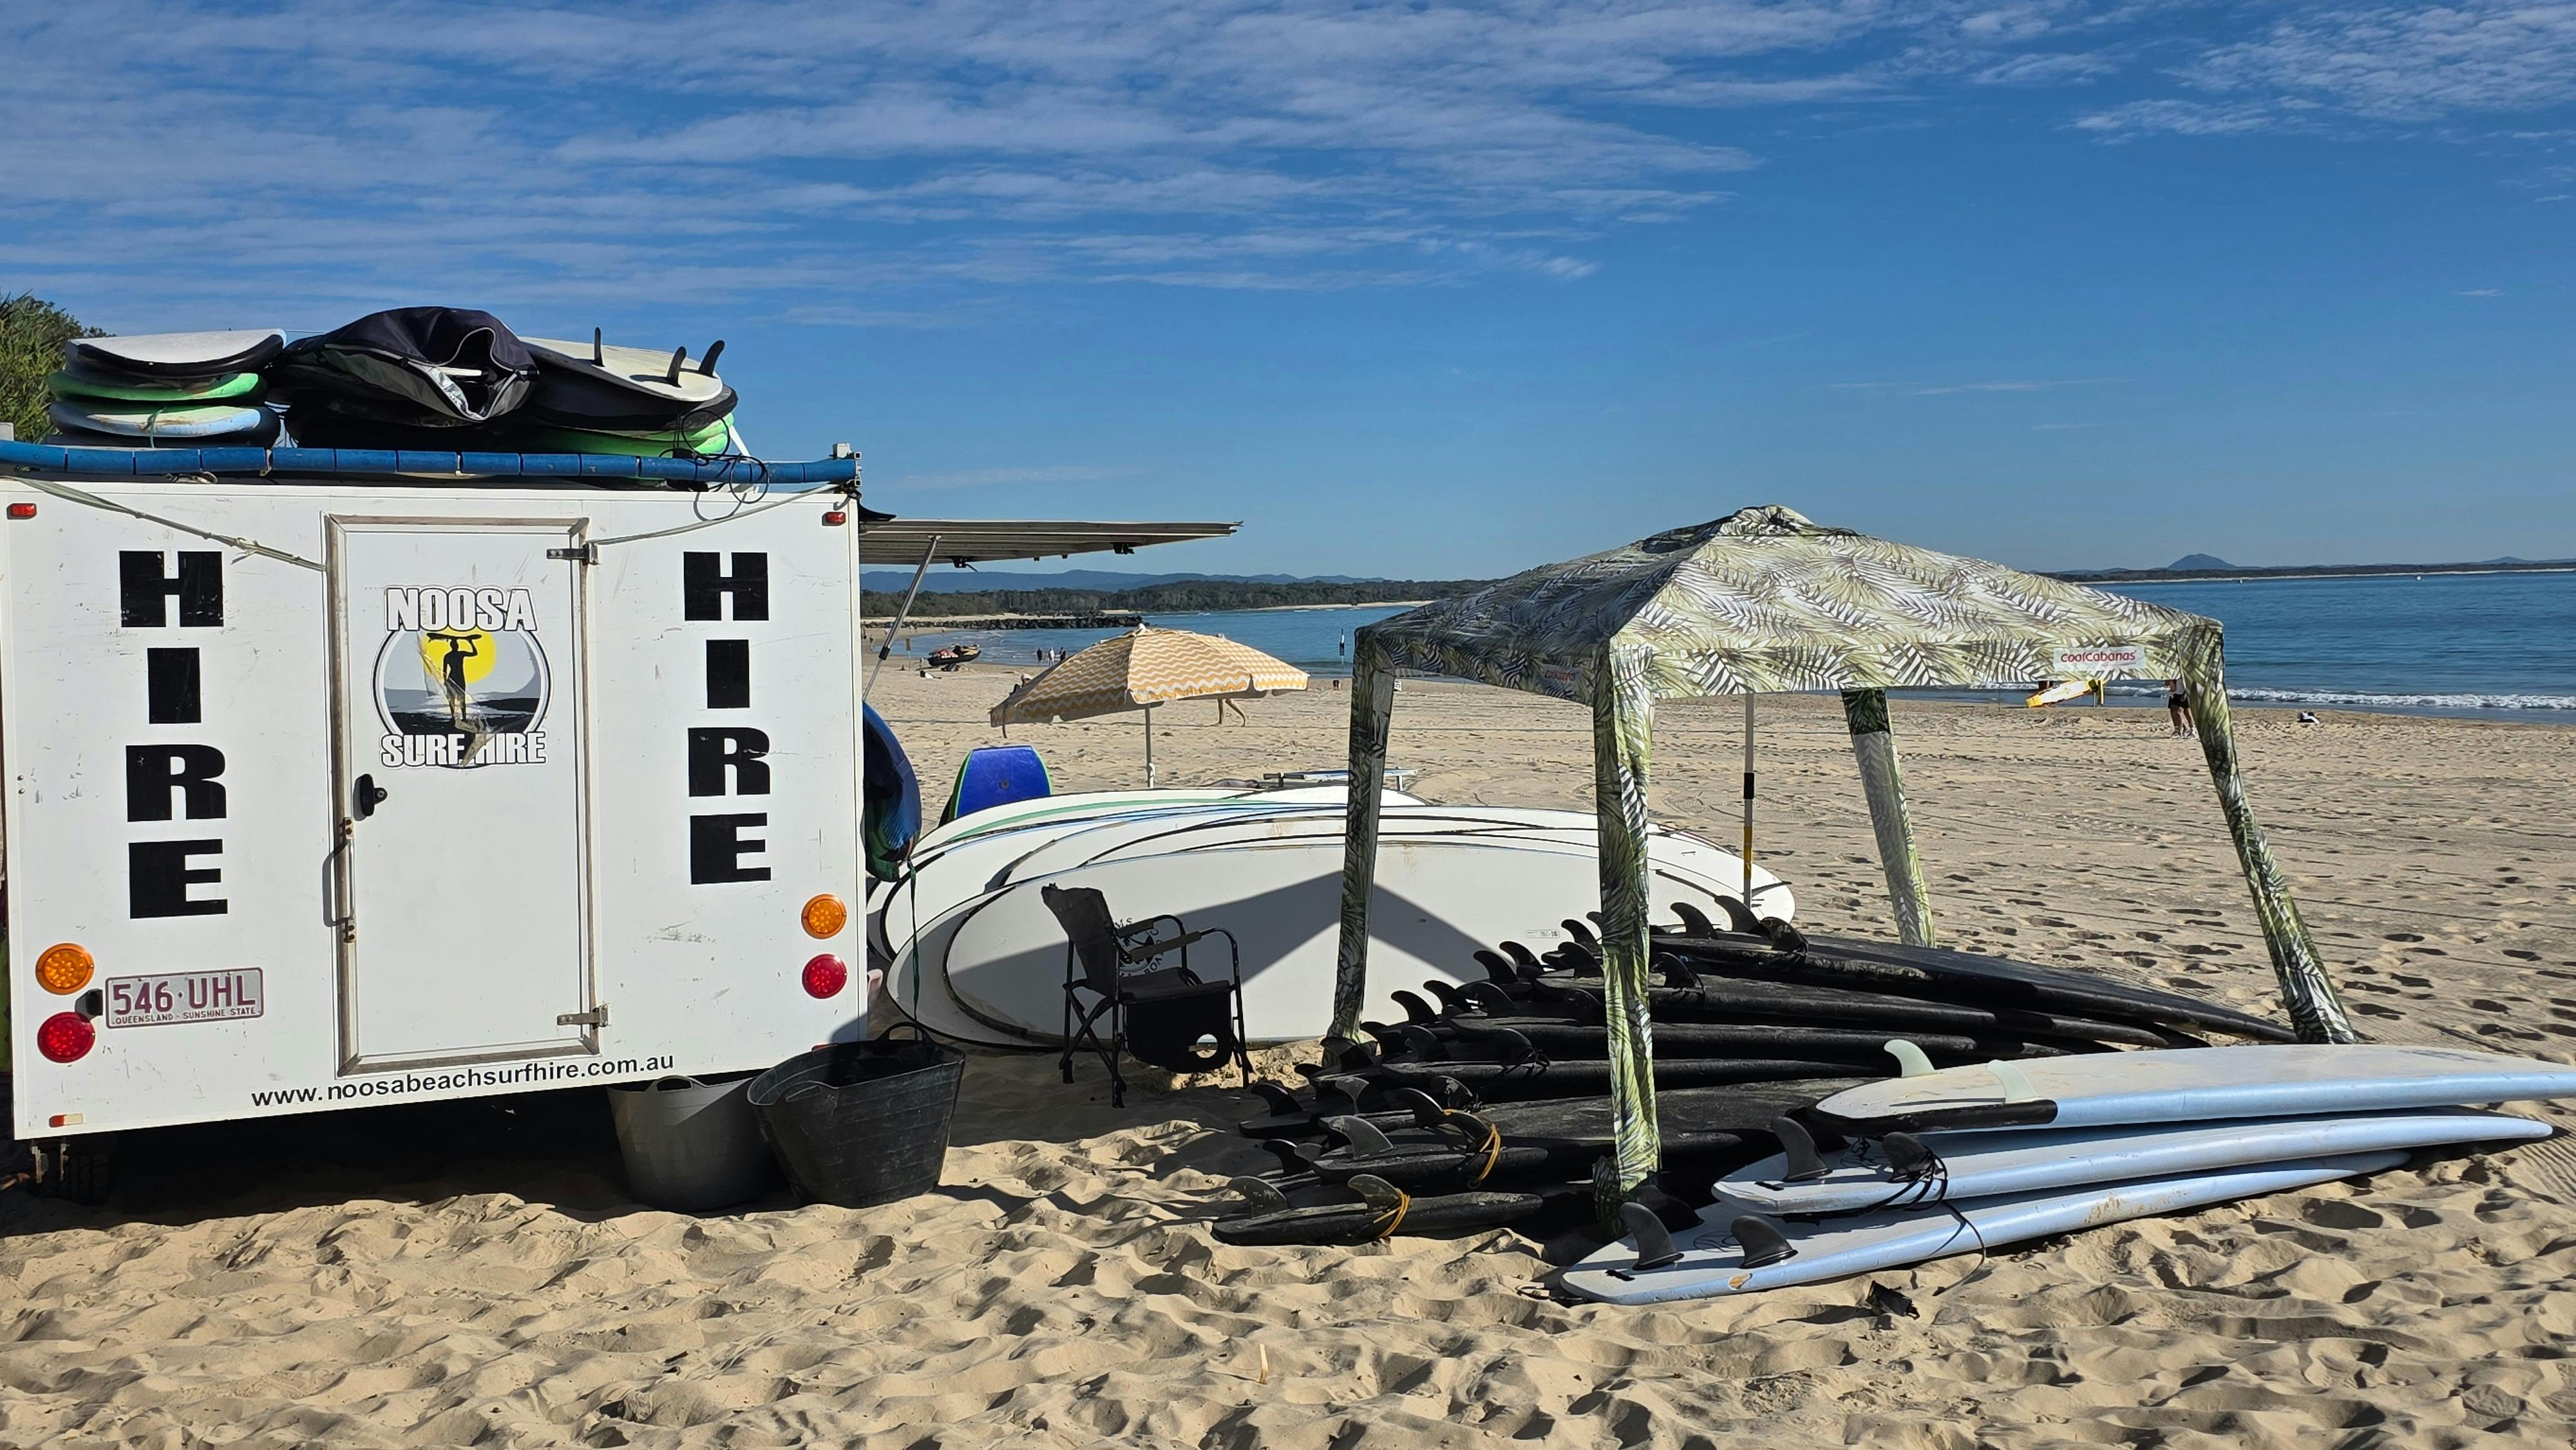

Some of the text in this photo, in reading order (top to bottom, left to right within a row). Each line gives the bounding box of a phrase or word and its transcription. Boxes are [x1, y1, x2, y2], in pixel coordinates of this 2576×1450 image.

[386, 587, 538, 631] NOOSA
[119, 551, 228, 919] HIRE
[683, 552, 771, 884] HIRE
[381, 731, 546, 767] SURF HIRE
[113, 975, 256, 1015] 546 UHL
[115, 1013, 173, 1024] QUEENSLAND
[183, 1009, 225, 1019] SUNSHINE
[230, 1007, 256, 1015] STATE
[252, 1055, 674, 1106] www.noosabeachsurfhire.com.au
